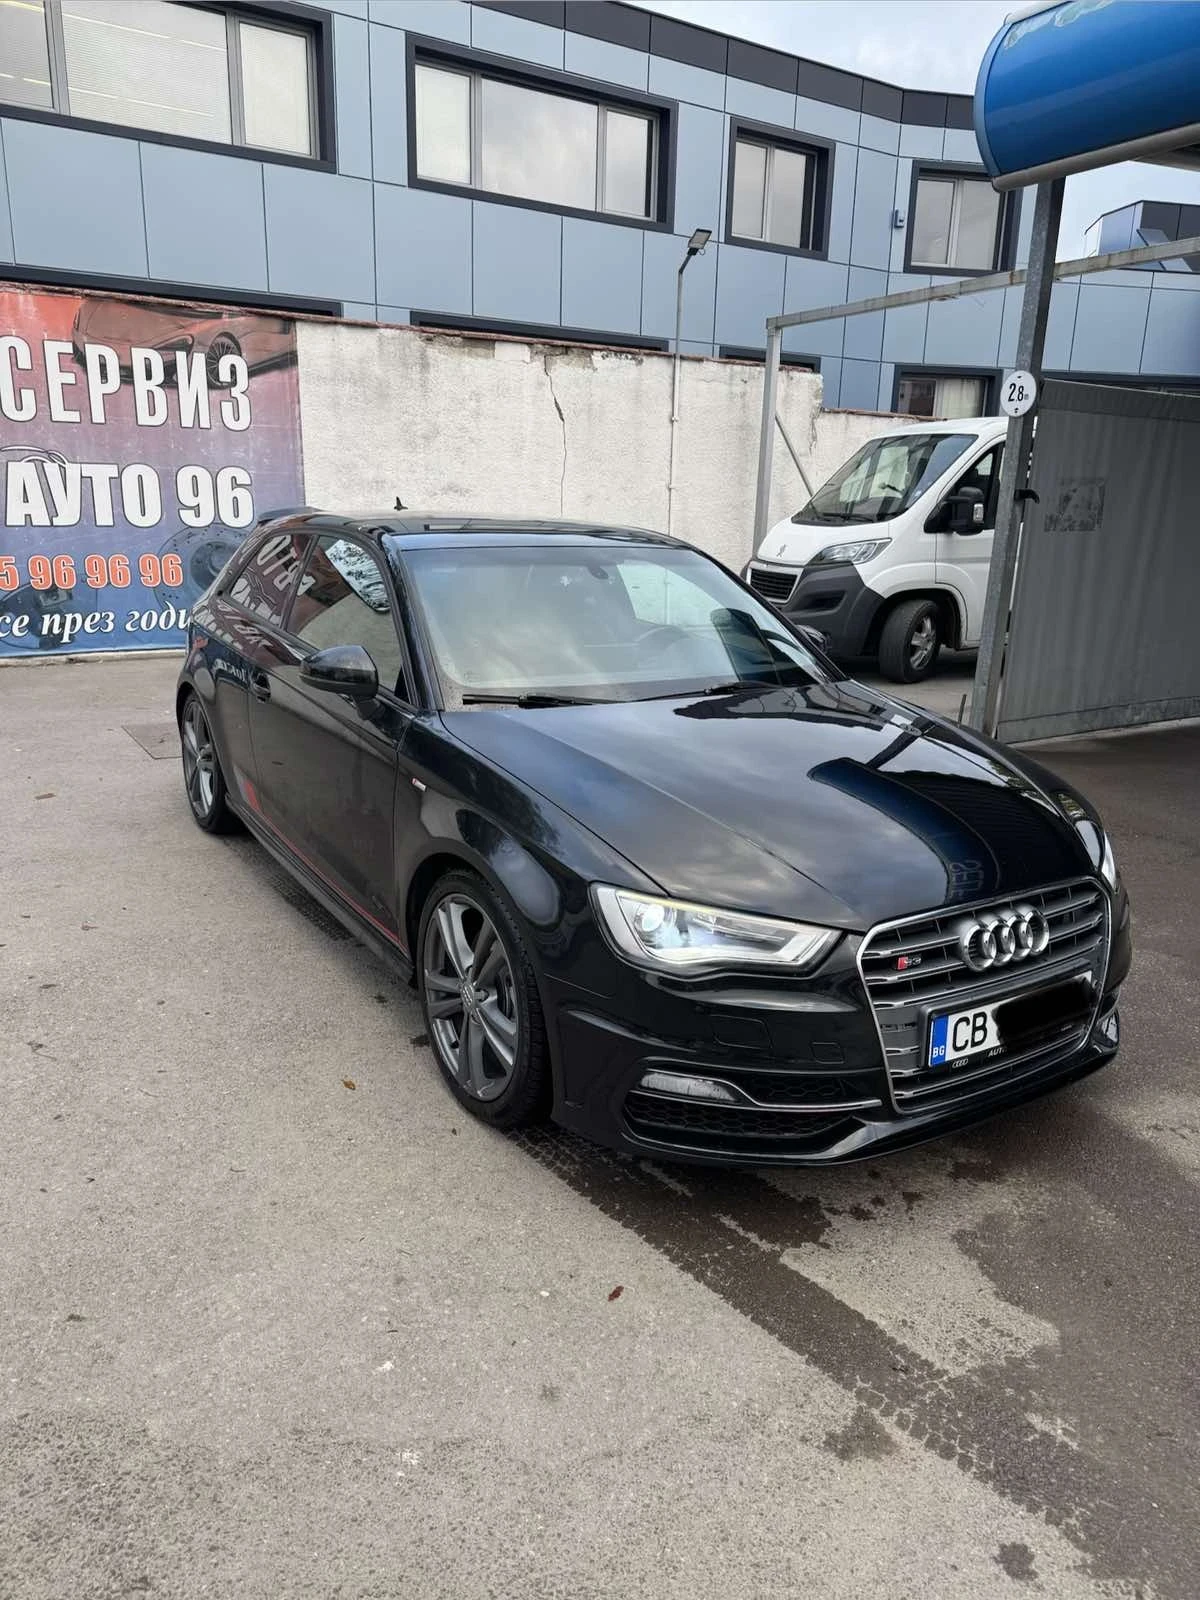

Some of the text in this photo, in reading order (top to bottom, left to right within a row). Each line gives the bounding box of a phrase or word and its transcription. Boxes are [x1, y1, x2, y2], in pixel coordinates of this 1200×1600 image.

[0, 335, 252, 431] СЕРВИЗ
[6, 461, 254, 528] АУТО 96
[0, 553, 184, 591] 5 96 96 96
[41, 609, 115, 644] през
[932, 1045, 945, 1058] BG
[952, 1012, 988, 1052] CB
